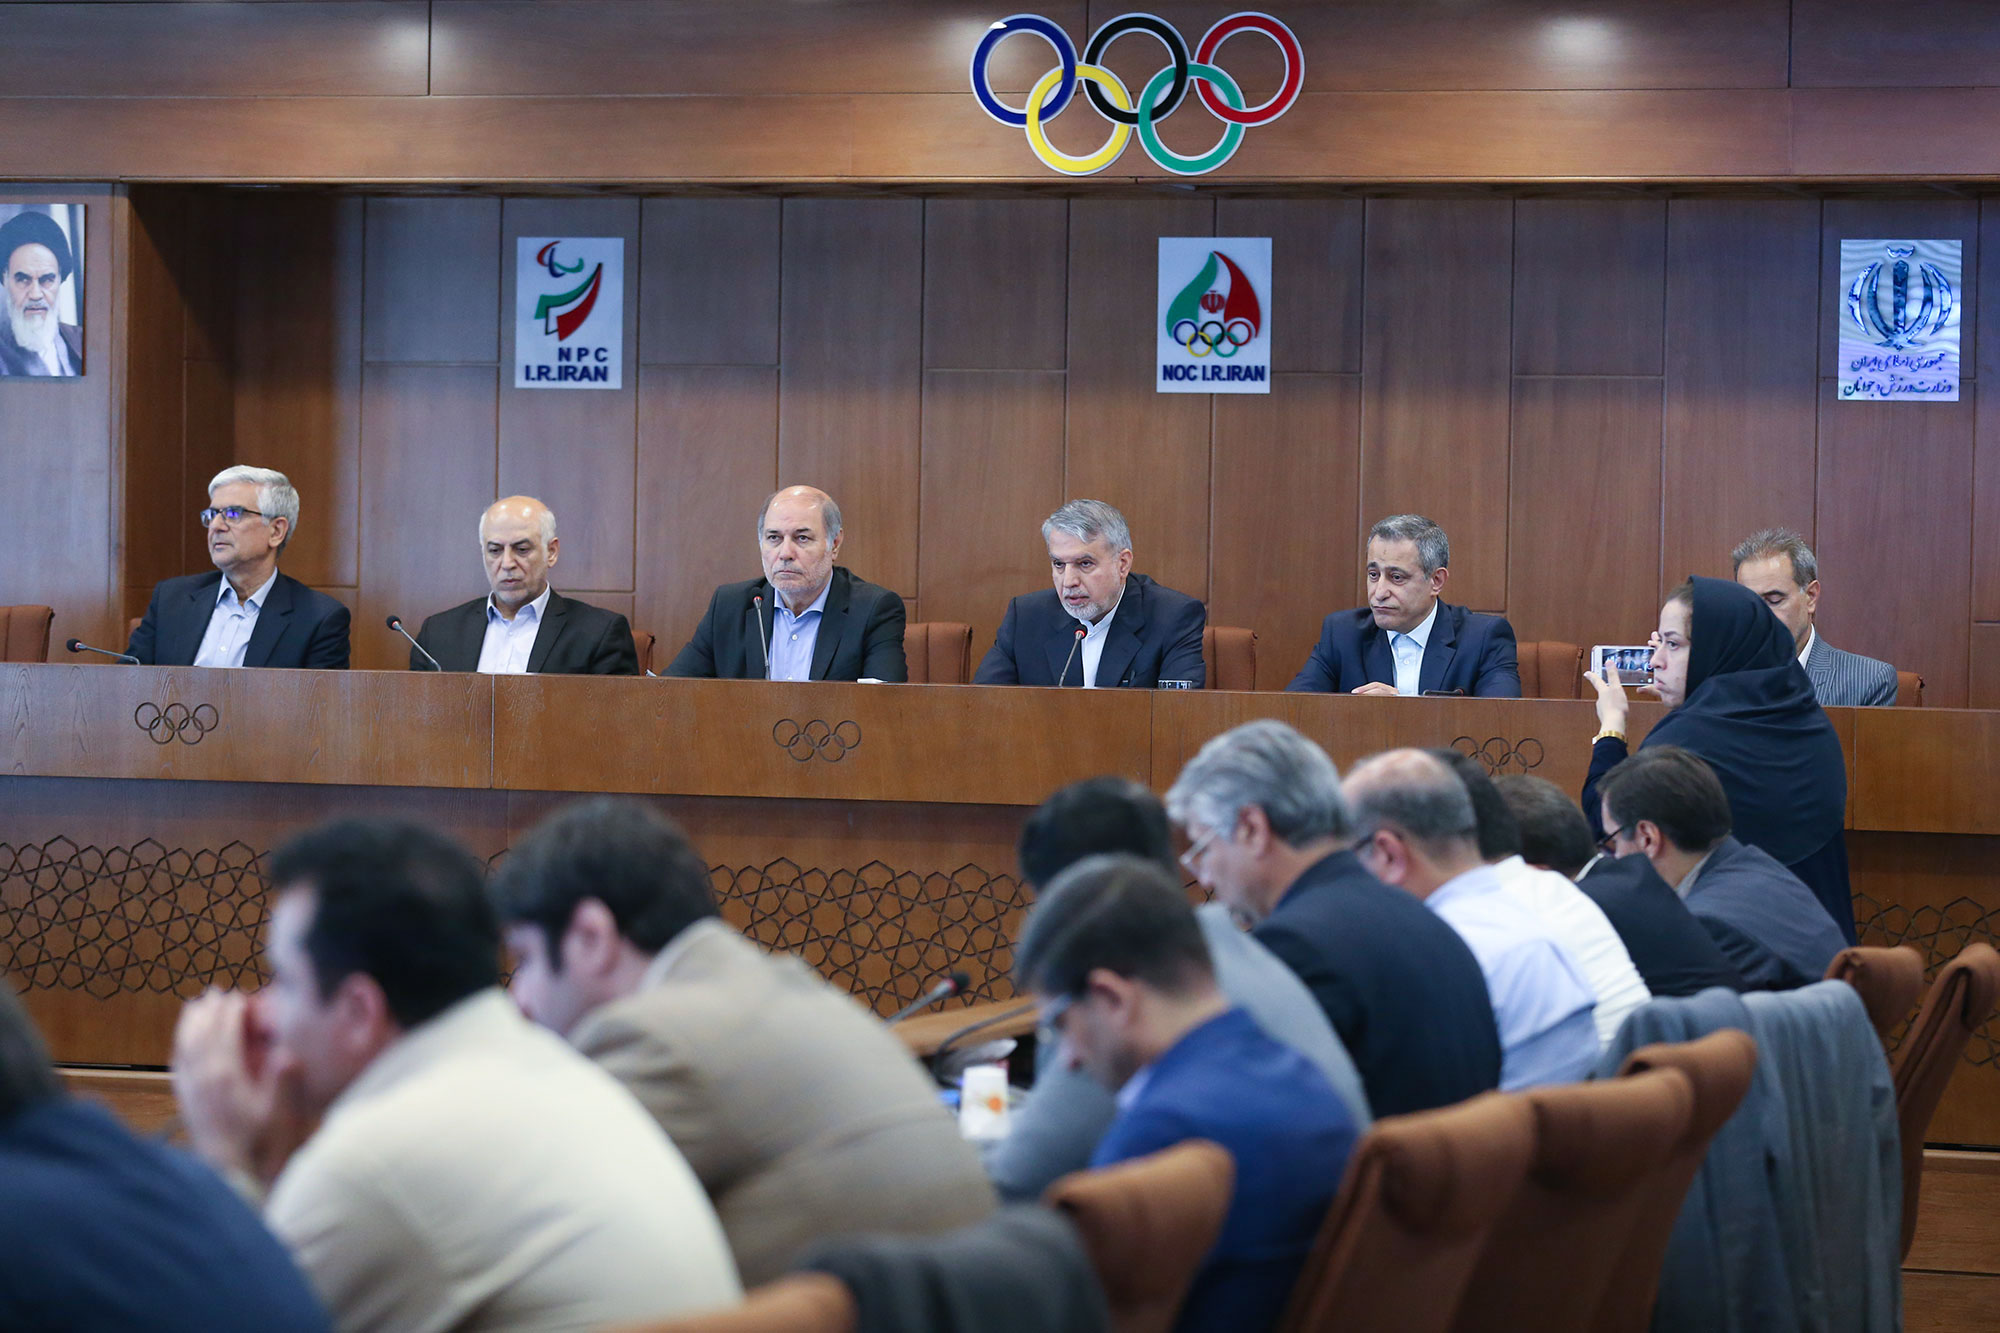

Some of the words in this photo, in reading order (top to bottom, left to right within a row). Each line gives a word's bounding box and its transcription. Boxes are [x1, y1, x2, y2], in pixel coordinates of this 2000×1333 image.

[525, 365, 608, 381] I.R.IRAN
[1162, 364, 1198, 381] NOC
[1202, 365, 1265, 382] I.R.IRAN
